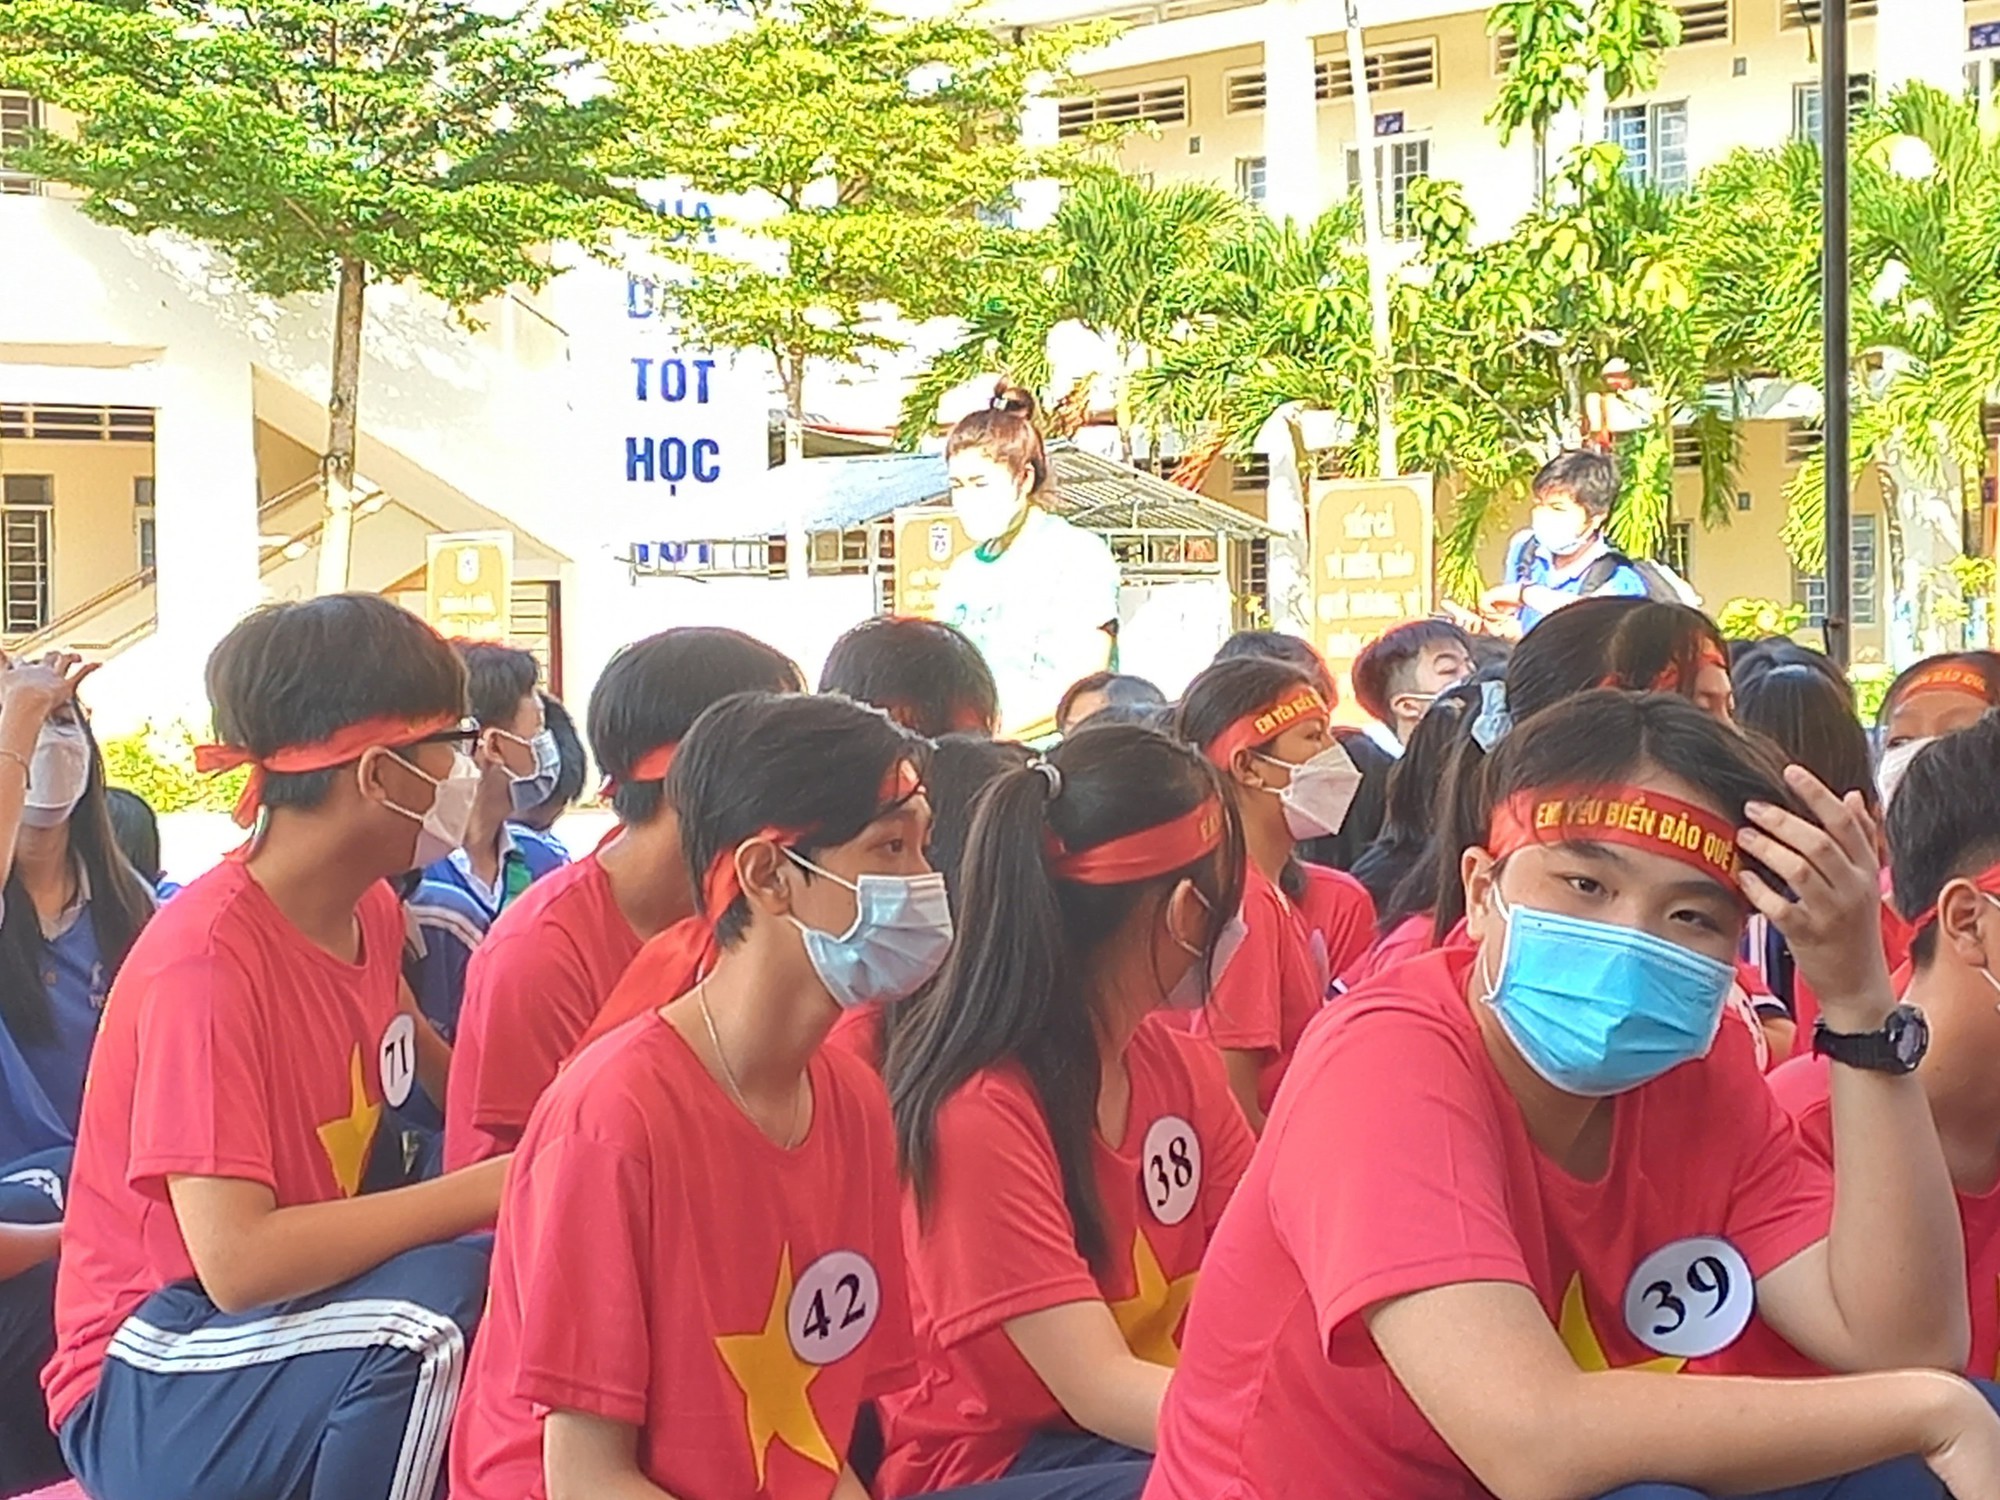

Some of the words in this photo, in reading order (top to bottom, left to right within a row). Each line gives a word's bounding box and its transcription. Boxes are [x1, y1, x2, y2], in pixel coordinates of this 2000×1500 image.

[626, 437, 721, 497] HỌC
[384, 1035, 409, 1088] 71
[1150, 1136, 1193, 1207] 38
[802, 1272, 867, 1340] 42
[1641, 1255, 1730, 1335] 39
